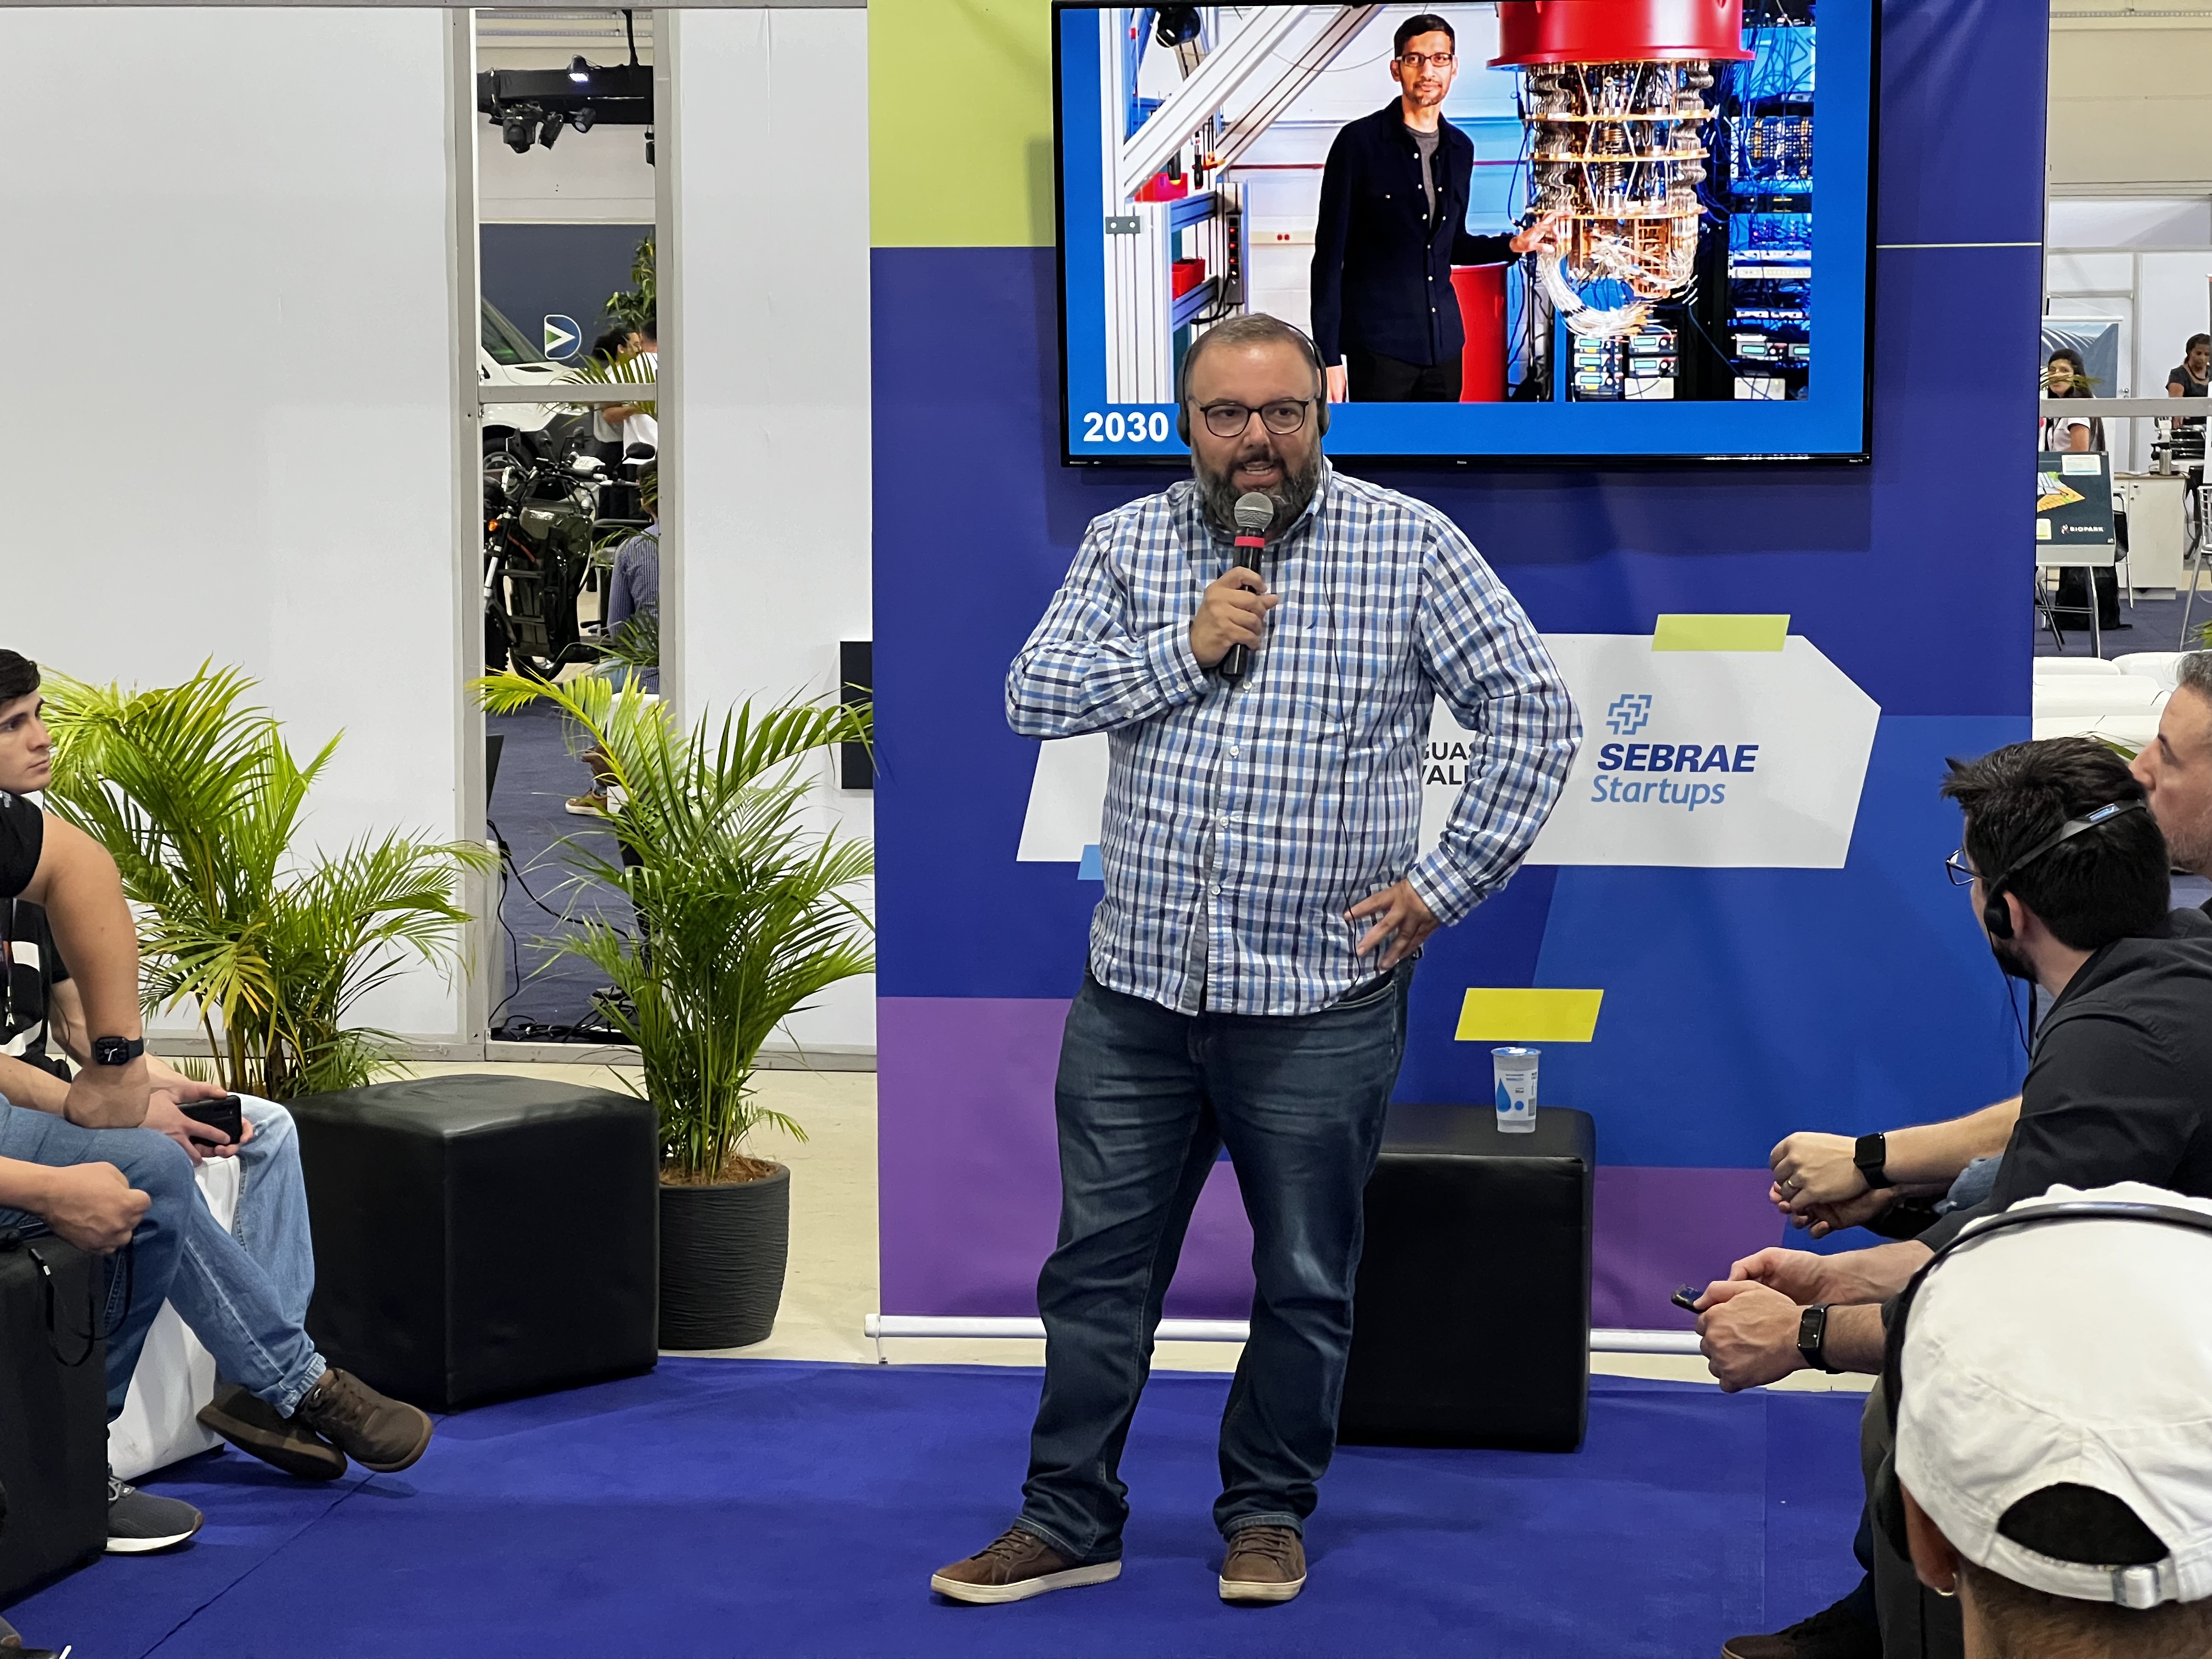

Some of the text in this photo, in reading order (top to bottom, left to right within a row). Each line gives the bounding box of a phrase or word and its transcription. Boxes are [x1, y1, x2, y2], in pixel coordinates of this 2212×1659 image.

[1083, 411, 1169, 442] 2030
[1424, 742, 1470, 760] UA
[1597, 744, 1759, 772] SEBRAE
[1592, 775, 1725, 811] Startups
